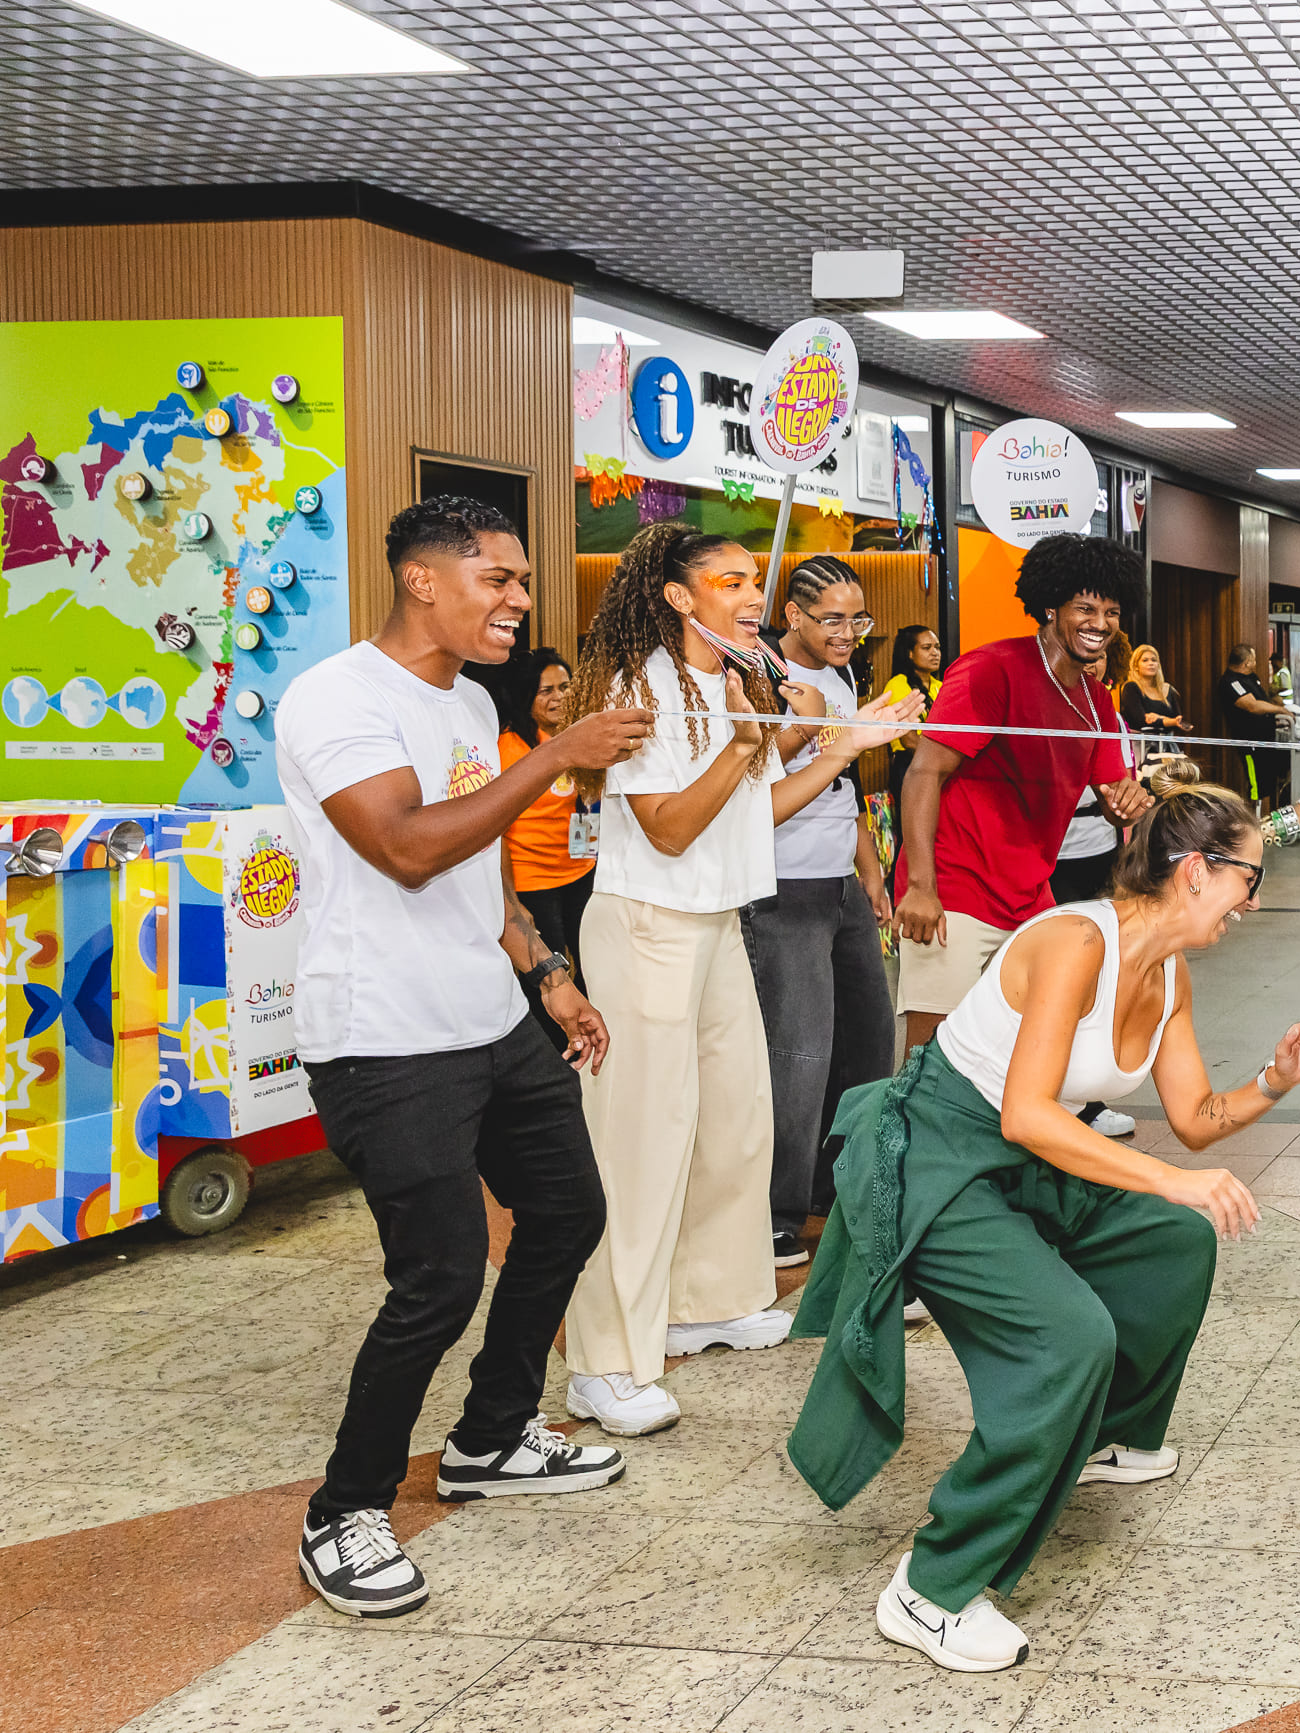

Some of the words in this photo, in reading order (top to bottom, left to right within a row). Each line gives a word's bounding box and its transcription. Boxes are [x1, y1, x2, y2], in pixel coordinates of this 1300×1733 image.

[794, 355, 831, 372] UM
[777, 369, 839, 405] ESTADO
[795, 398, 818, 410] DE
[776, 400, 835, 445] ALEGRIA
[1006, 468, 1061, 482] TURISMO
[1009, 499, 1037, 507] GOVERNO
[1047, 497, 1069, 505] ESTADO
[452, 761, 480, 781] UM
[247, 849, 280, 869] UM
[241, 855, 292, 895] ESTADO
[259, 879, 278, 893] DE
[245, 876, 295, 917] ALEGRIA
[250, 1006, 293, 1024] TURISMO
